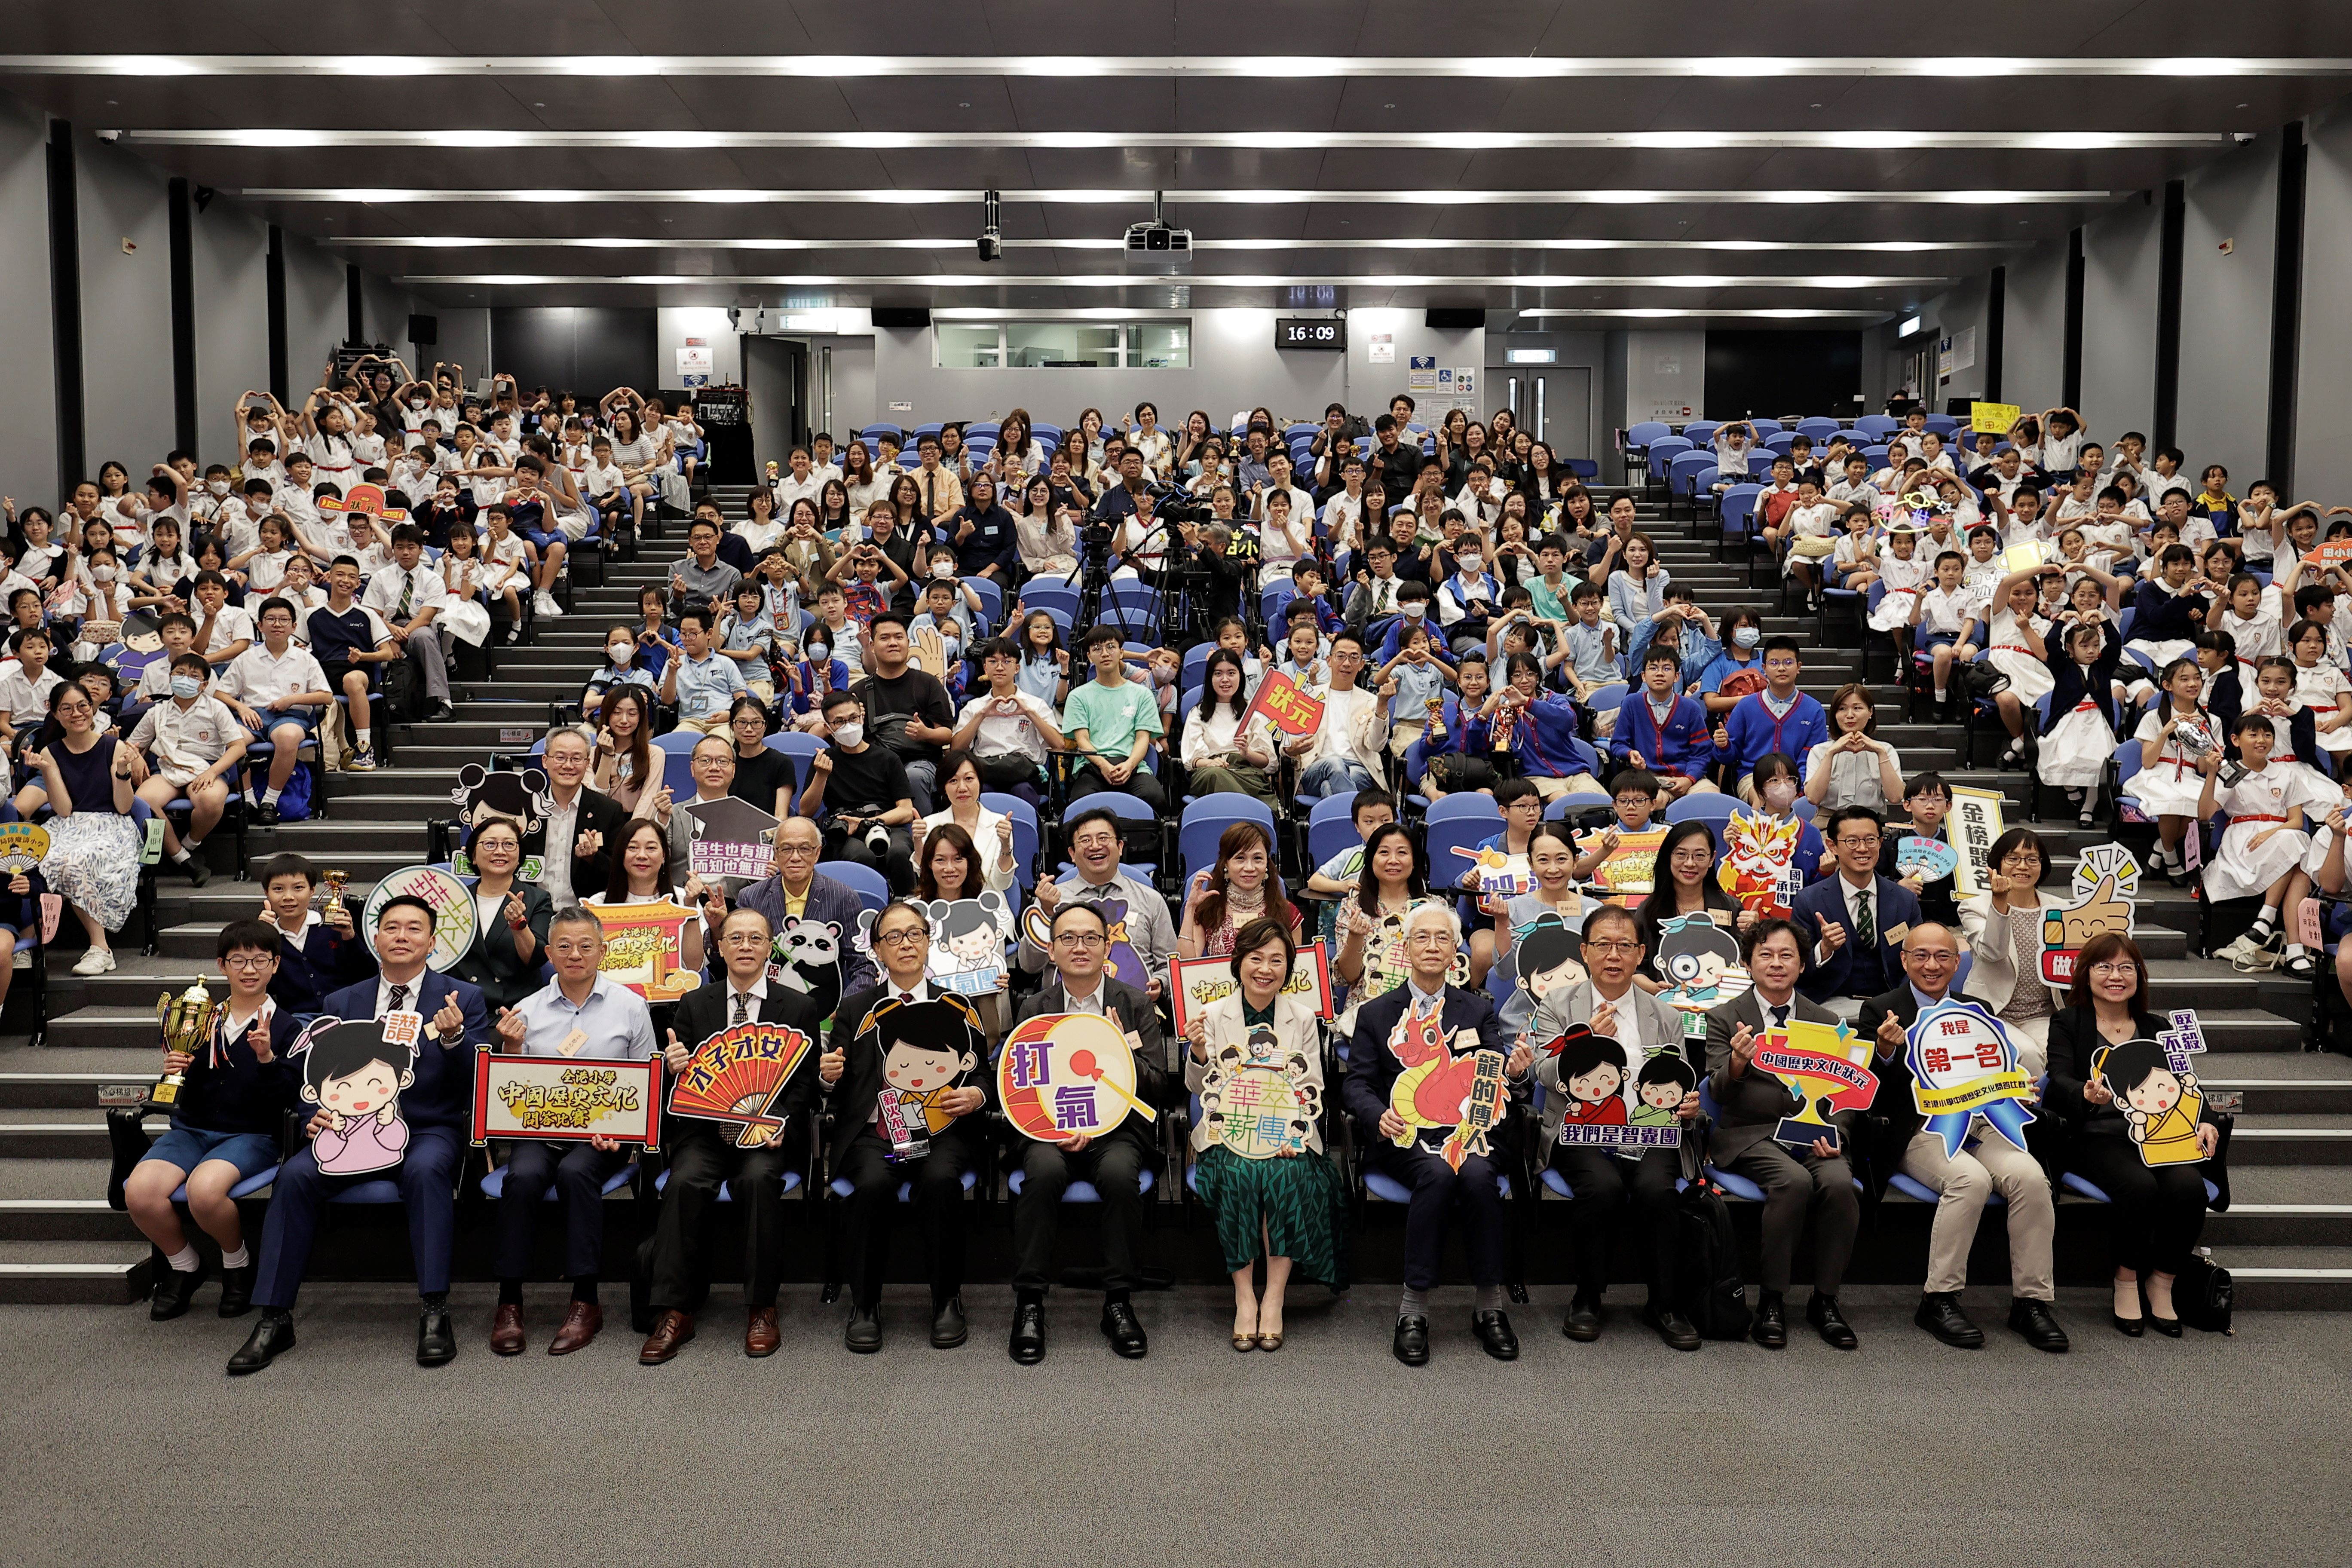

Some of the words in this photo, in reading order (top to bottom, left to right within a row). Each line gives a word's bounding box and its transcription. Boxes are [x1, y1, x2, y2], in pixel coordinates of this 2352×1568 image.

[1288, 327, 1335, 340] 16:09
[349, 500, 377, 513] 狀元
[1265, 683, 1317, 729] 狀元
[693, 842, 771, 860] 吾生也有涯
[694, 859, 769, 877] 而知也無涯
[1776, 881, 1788, 903] 承傳
[620, 925, 661, 938] 全港小學
[386, 1013, 419, 1043] 讚
[1940, 1020, 1971, 1036] 我是
[2174, 1013, 2201, 1050] 堅毅
[687, 1035, 783, 1093] 才子才女
[1924, 1043, 2002, 1073] 第一名
[2161, 1034, 2189, 1072] 不屈
[561, 1069, 617, 1085] 全港小學
[1761, 1052, 1870, 1089] 中國歷史文化狀元
[100, 1087, 132, 1096] 小心梯級
[497, 1080, 640, 1112] 中國歷史文化
[1923, 1080, 2026, 1109] 全港小學中國歷史文化問答比賽
[2208, 1093, 2223, 1102] 梯級
[1463, 1054, 1501, 1154] 龍的傳人
[522, 1107, 590, 1129] 問答比賽
[882, 1092, 909, 1142] 薪火不熄
[1563, 1125, 1678, 1145] 我們是智囊團
